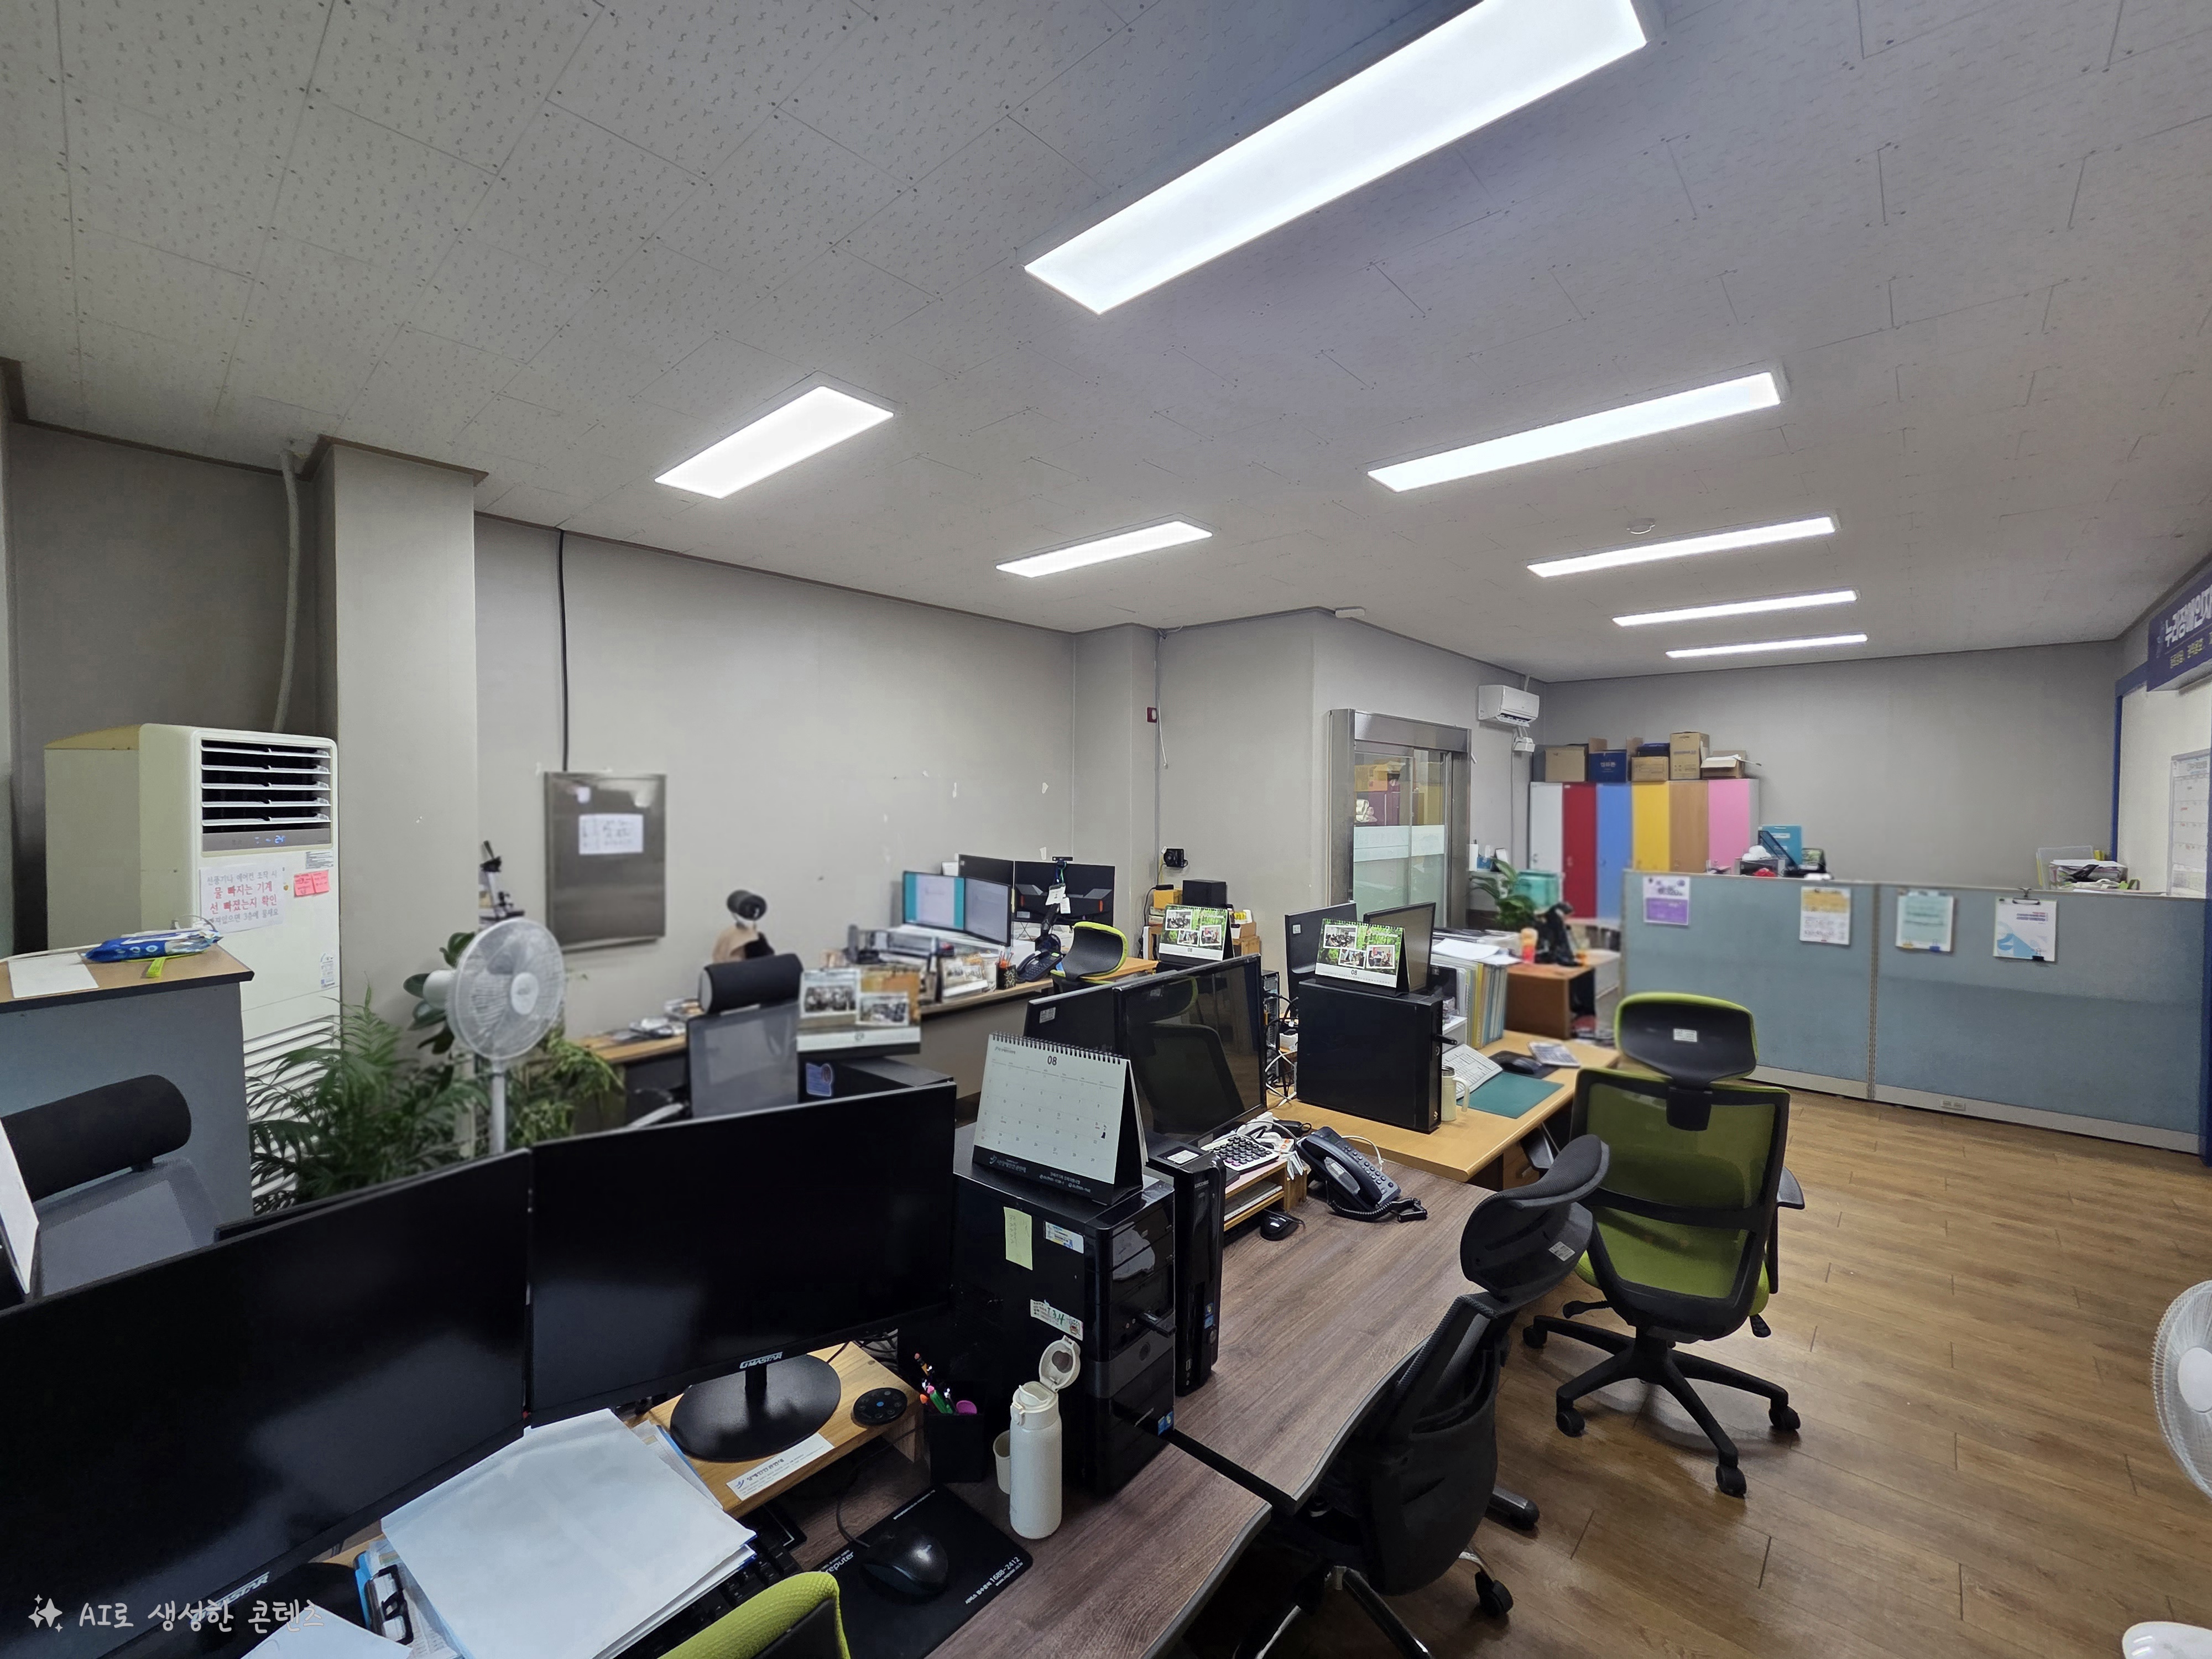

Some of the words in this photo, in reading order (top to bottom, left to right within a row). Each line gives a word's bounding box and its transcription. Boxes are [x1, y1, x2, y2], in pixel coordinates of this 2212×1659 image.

[214, 887, 223, 899] 물
[227, 884, 253, 897] 빠지는
[257, 880, 273, 893] 기계
[210, 902, 218, 915] 선
[223, 896, 257, 912] 빠졌는지
[262, 894, 277, 907] 확인
[1047, 1055, 1057, 1066] 08
[989, 1557, 1020, 1583] 1688-2412
